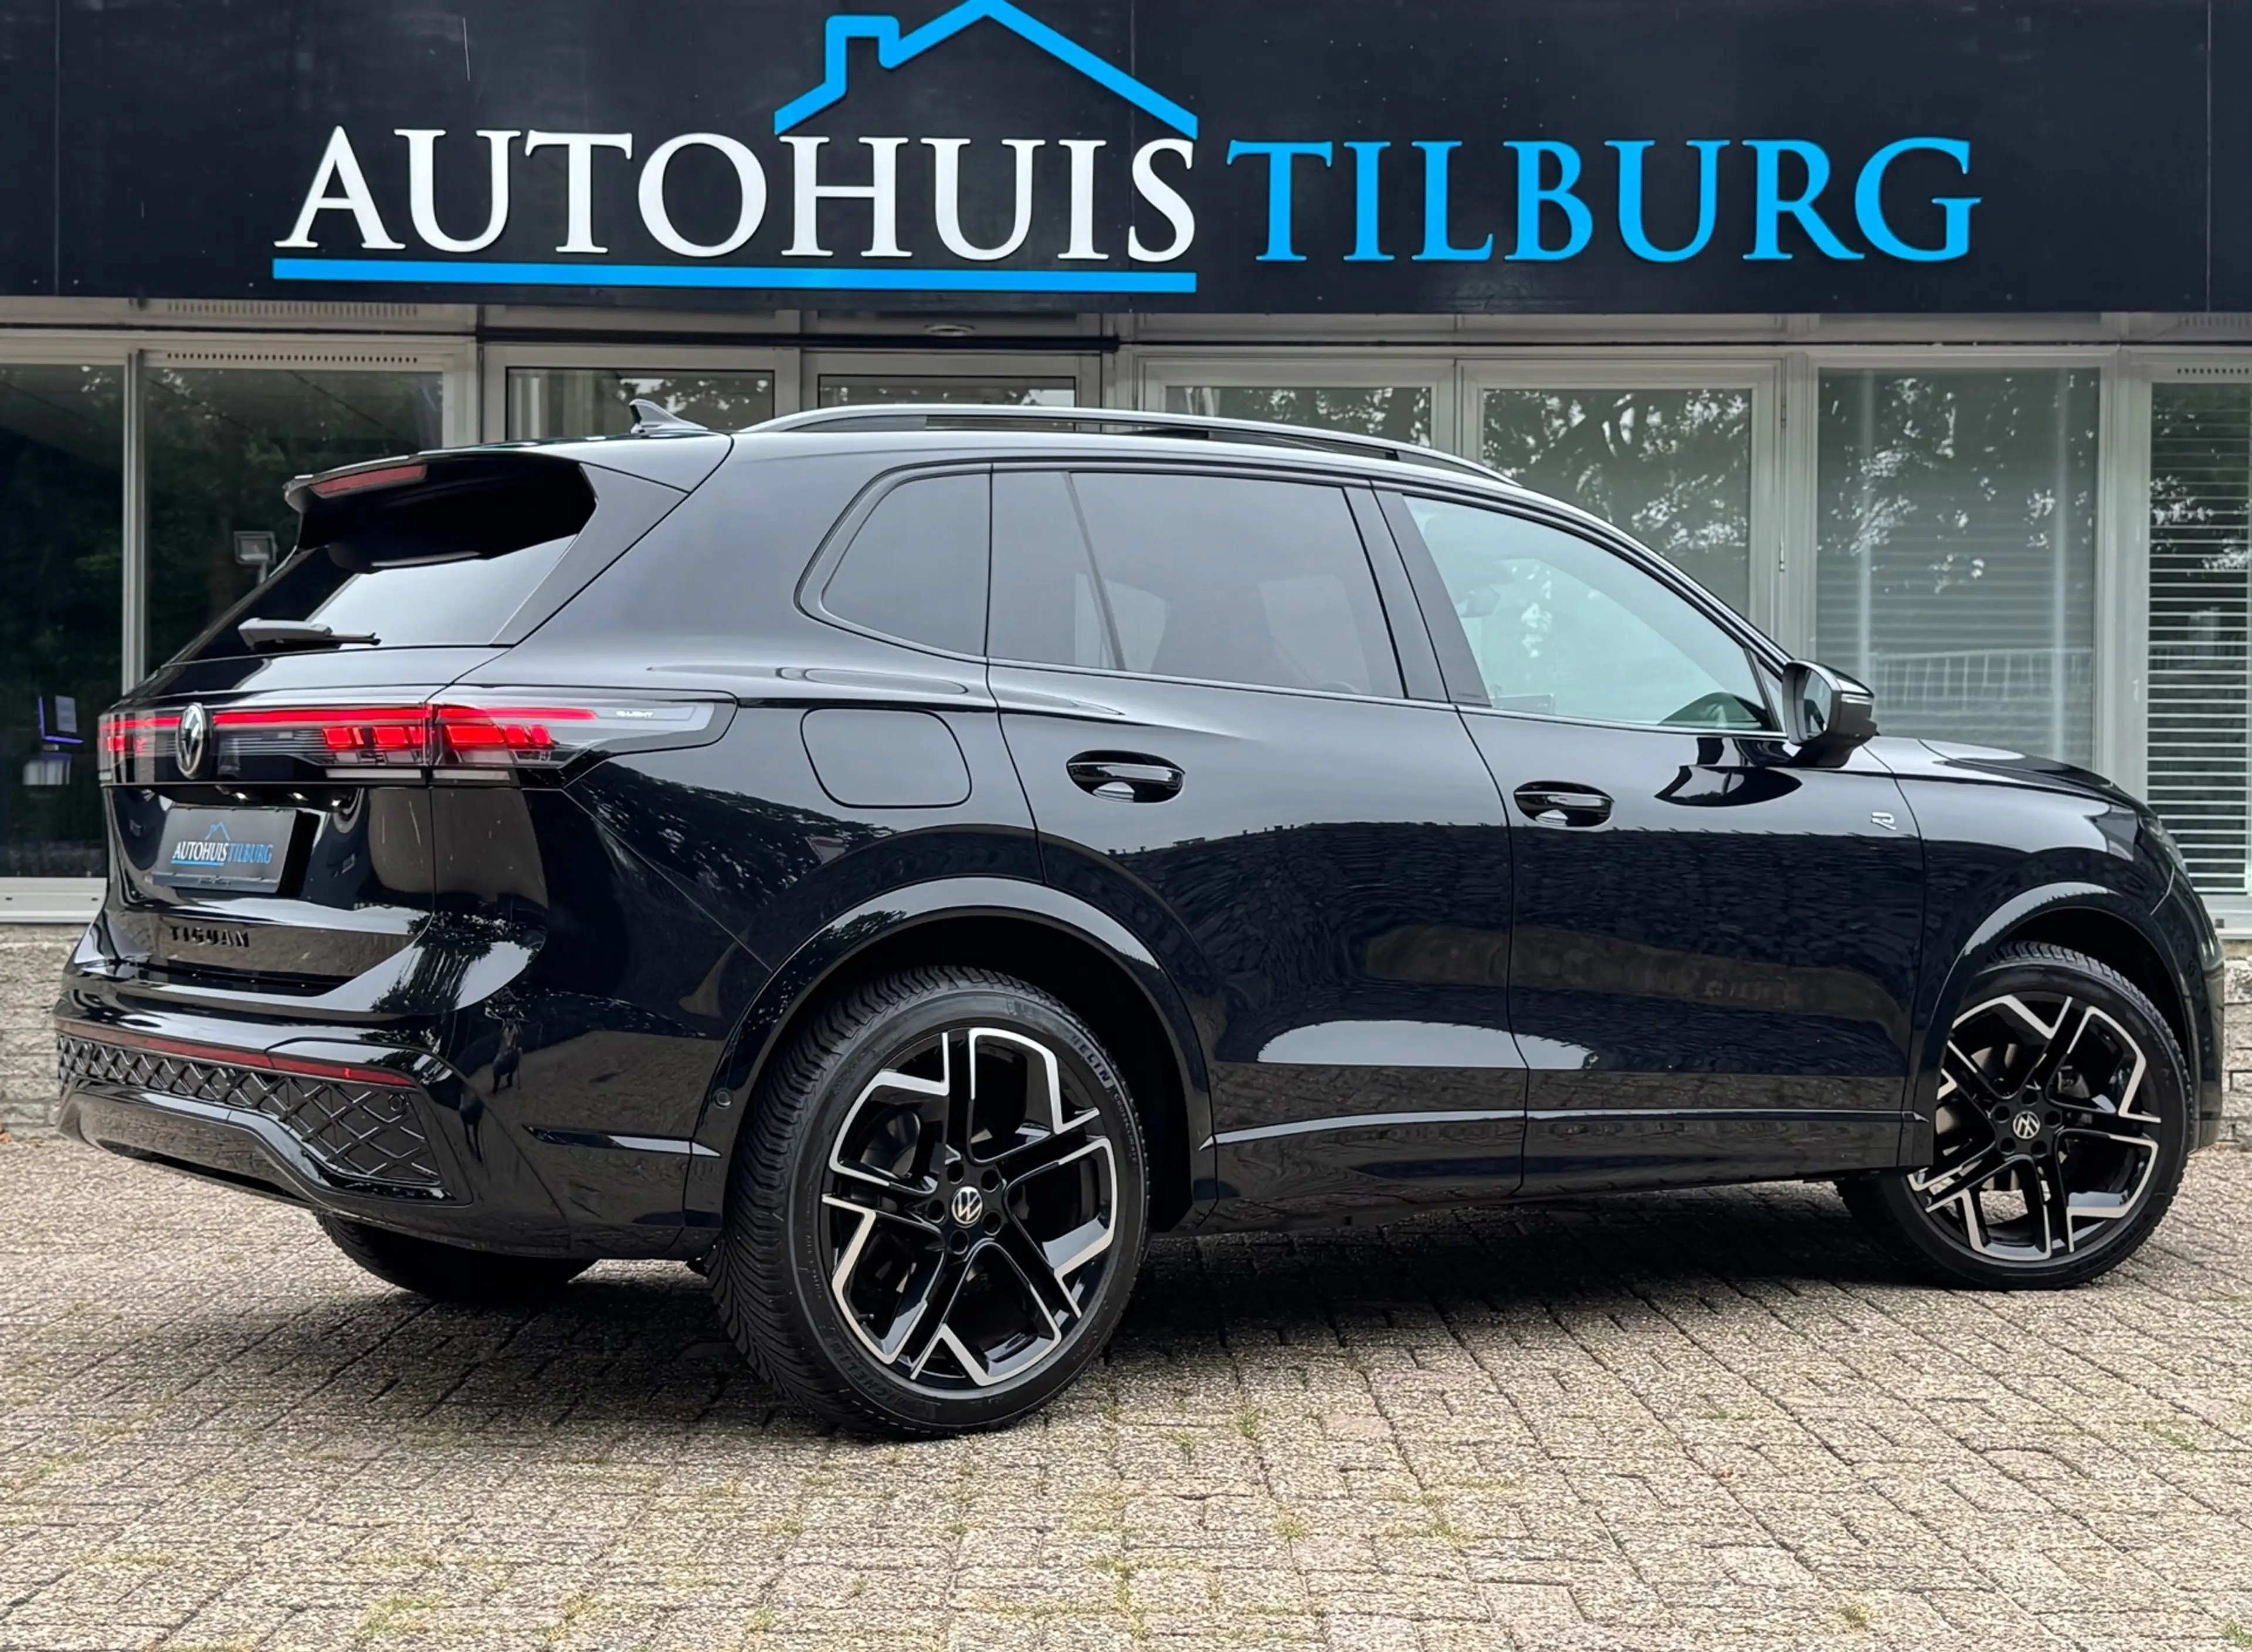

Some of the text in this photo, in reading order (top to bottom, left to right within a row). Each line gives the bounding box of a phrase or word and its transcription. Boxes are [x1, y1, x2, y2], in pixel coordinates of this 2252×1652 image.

[273, 125, 1983, 263] AUTOHUIS TILBURG
[172, 840, 273, 864] AUTOHUIS TILBURG
[170, 925, 250, 948] TIGUAN
